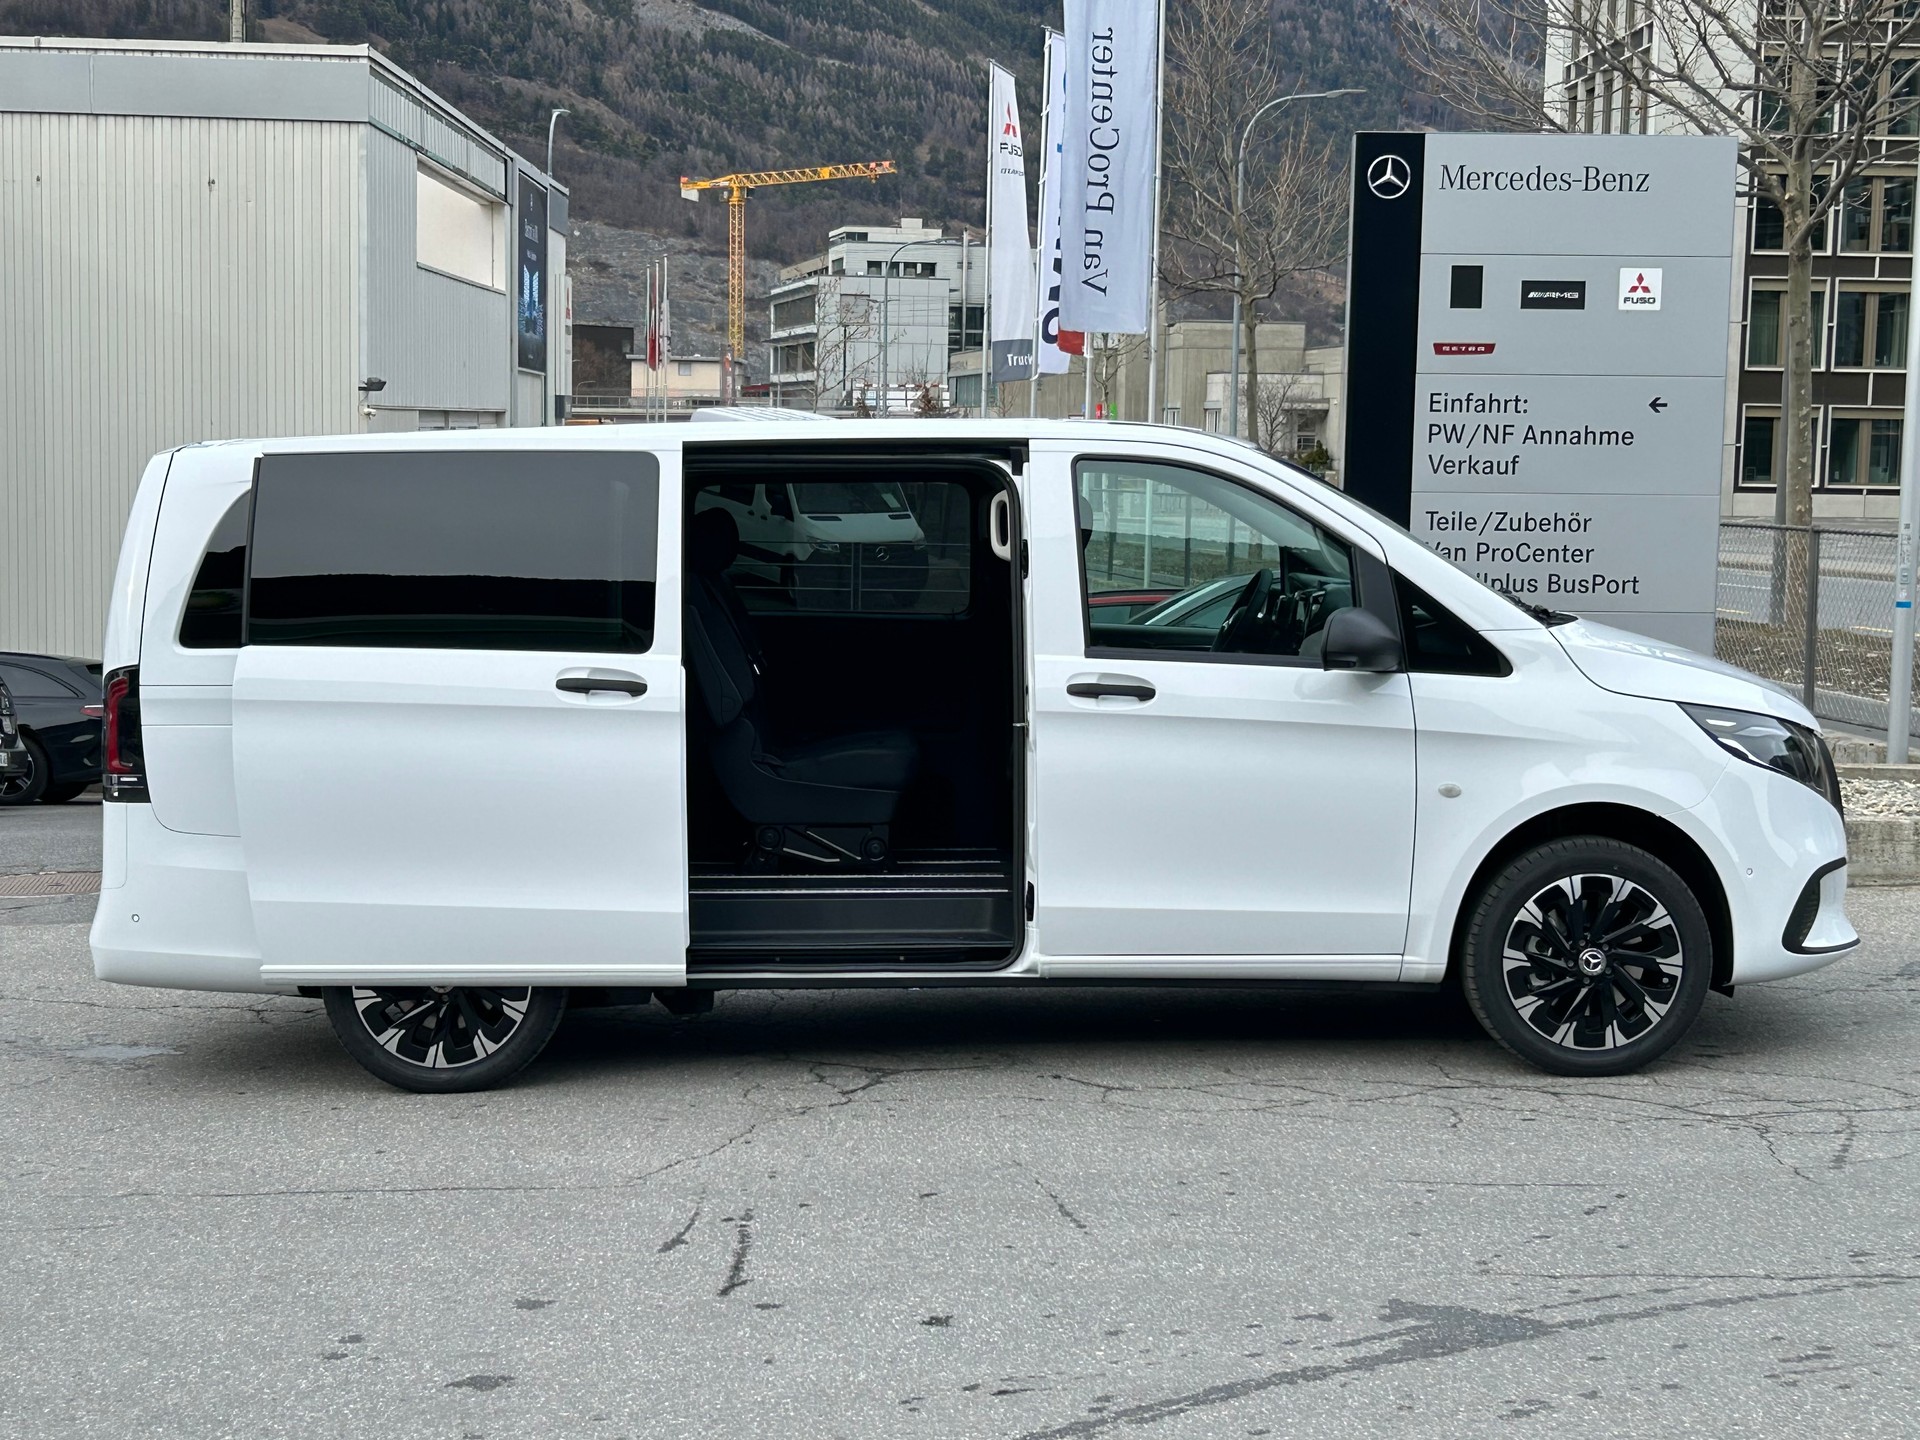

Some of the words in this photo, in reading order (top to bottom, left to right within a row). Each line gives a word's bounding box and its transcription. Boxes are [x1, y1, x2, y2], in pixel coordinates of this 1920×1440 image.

[1439, 164, 1650, 193] Mercedes-Benz
[1623, 297, 1656, 305] FUSO
[1429, 392, 1529, 415] Einfahrt:
[1428, 423, 1515, 448] PW/NF
[1522, 425, 1635, 446] Annahme
[1428, 454, 1520, 475] Verkauf
[1425, 510, 1592, 536] Teile/Zubehör
[1476, 542, 1594, 563] ProCenter
[1547, 573, 1640, 595] BusPort
